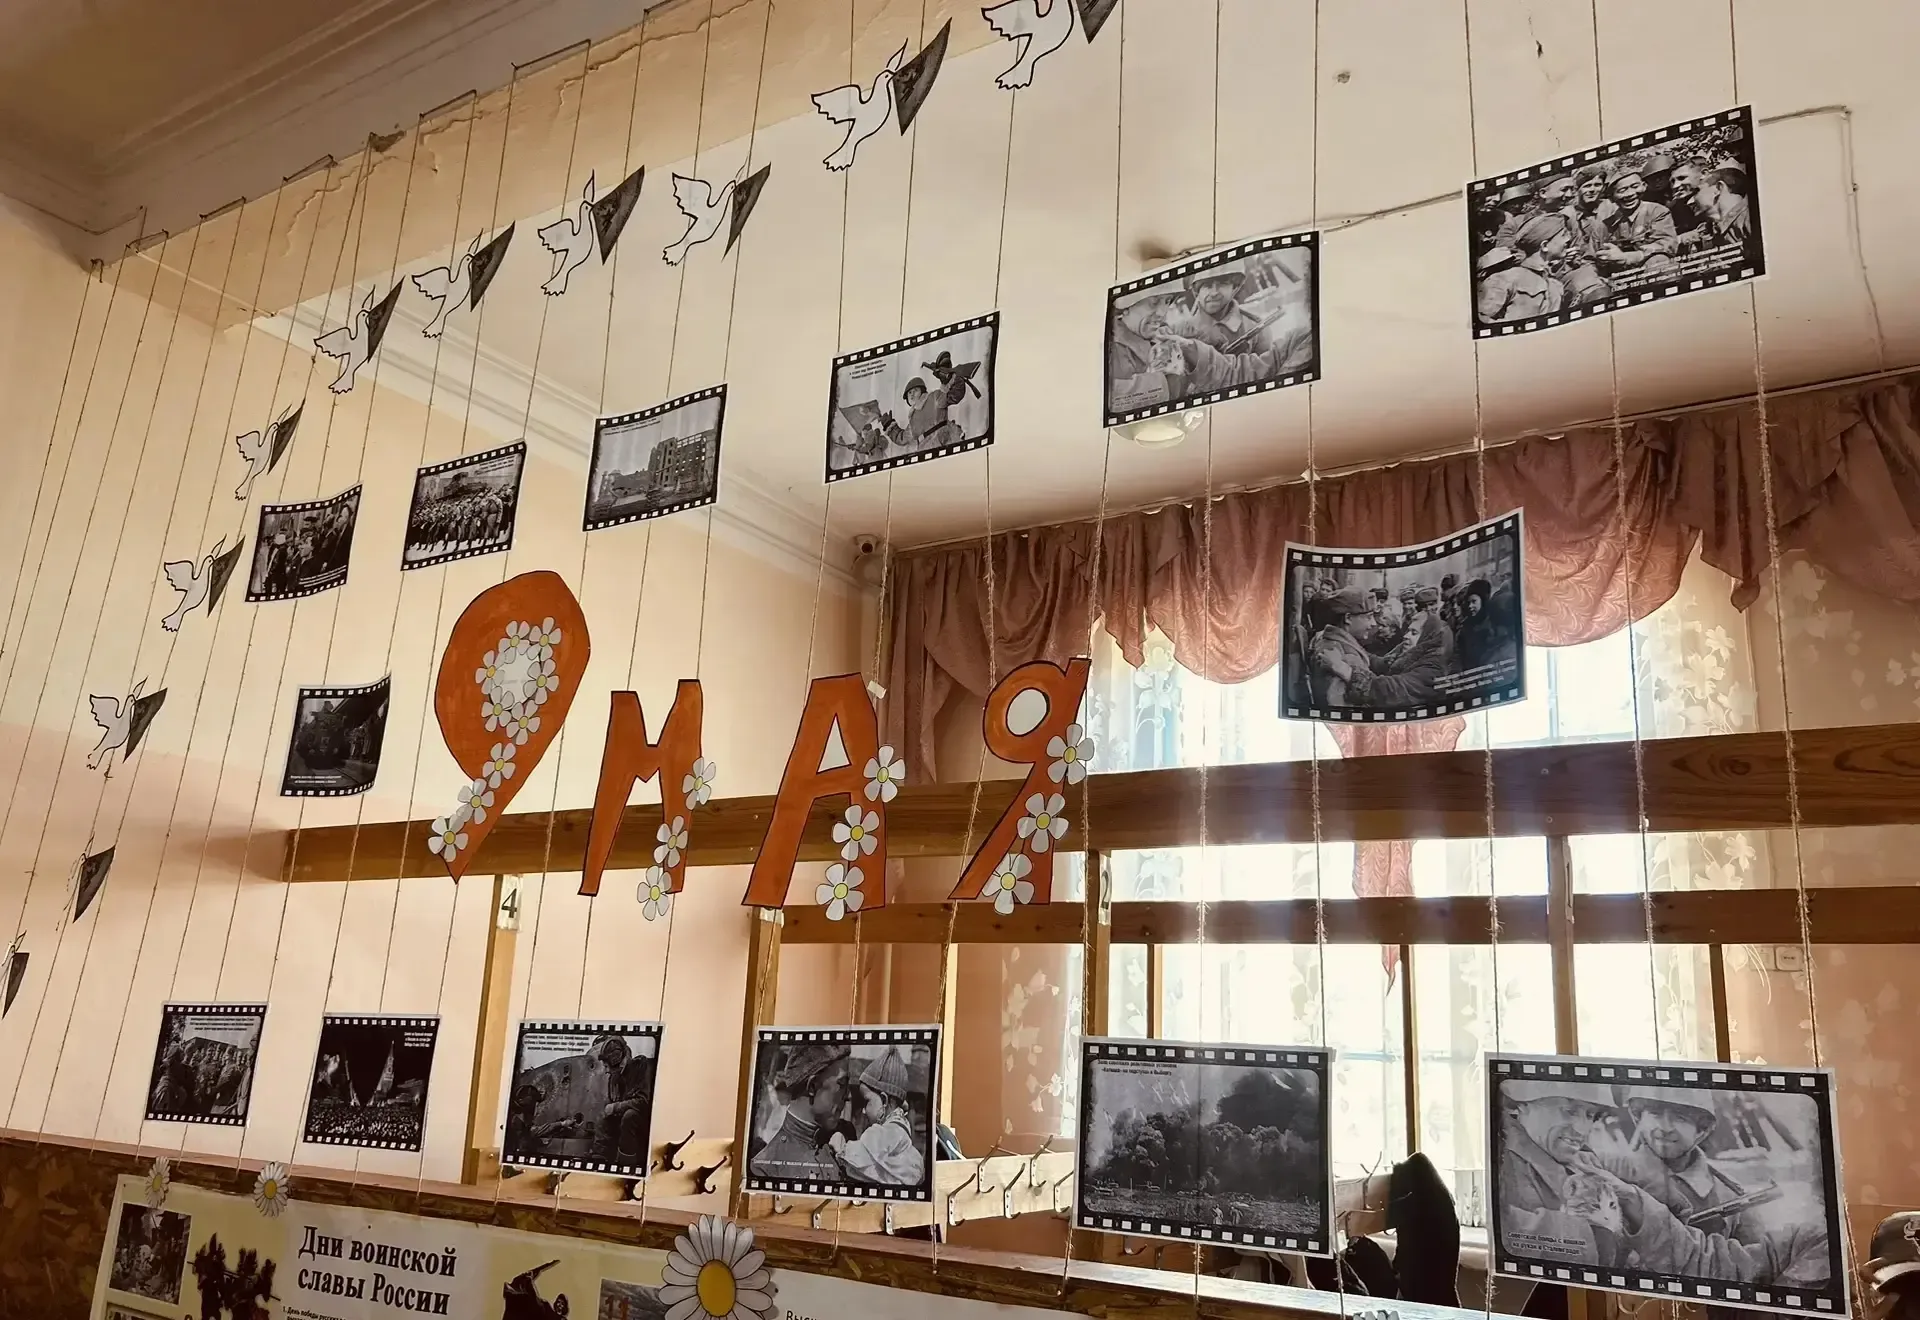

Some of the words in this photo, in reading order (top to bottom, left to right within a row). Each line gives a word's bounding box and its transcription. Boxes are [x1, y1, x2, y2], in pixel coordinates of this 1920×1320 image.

[433, 570, 590, 884] 9
[578, 658, 1092, 912] МАЯ
[501, 888, 518, 919] 4
[298, 1225, 344, 1261] Дни
[349, 1240, 457, 1277] воинской
[298, 1268, 366, 1299] славы
[370, 1272, 450, 1315] России
